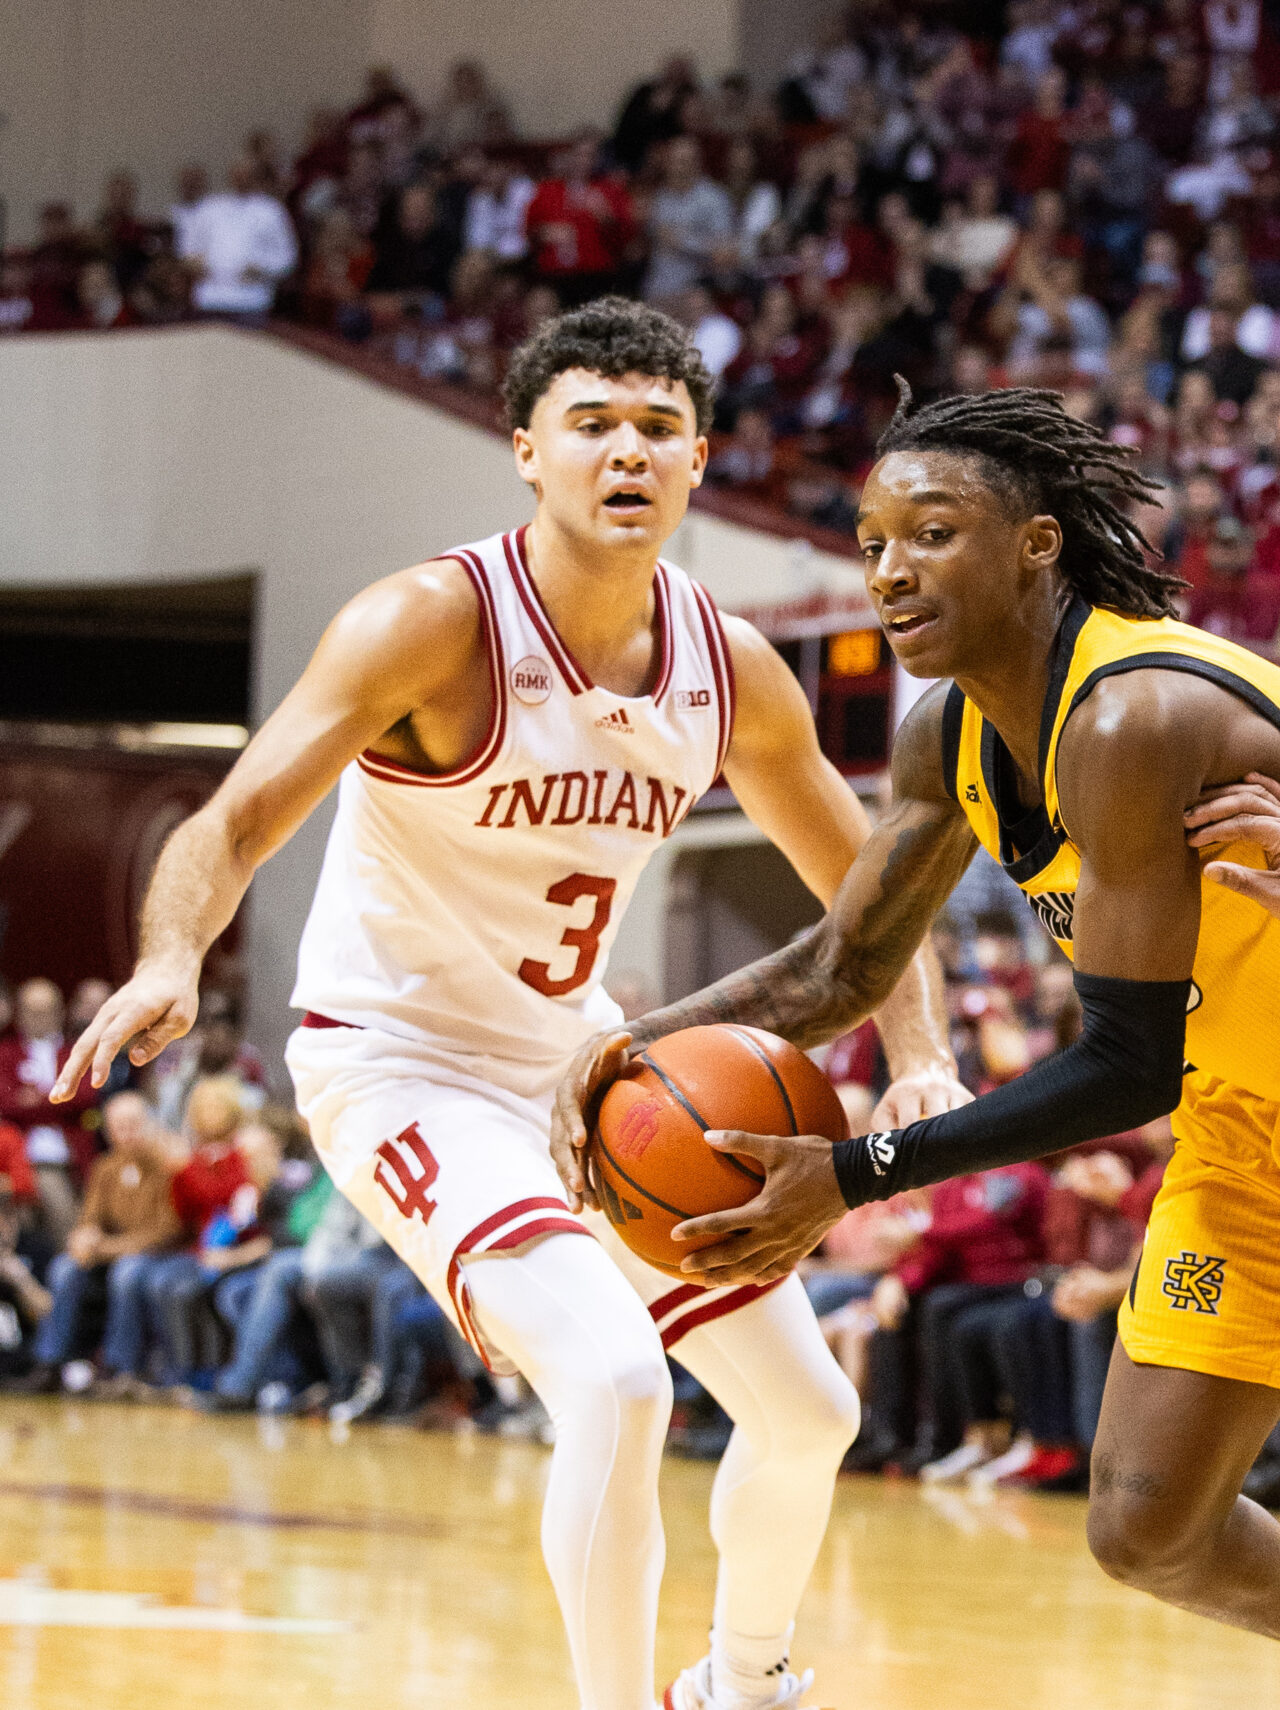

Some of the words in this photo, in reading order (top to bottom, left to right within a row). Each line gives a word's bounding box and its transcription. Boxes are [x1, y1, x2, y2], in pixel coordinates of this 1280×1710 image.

[514, 672, 549, 691] RMK
[594, 719, 635, 735] adidas
[474, 769, 697, 838] INDIAN
[517, 872, 617, 997] 3
